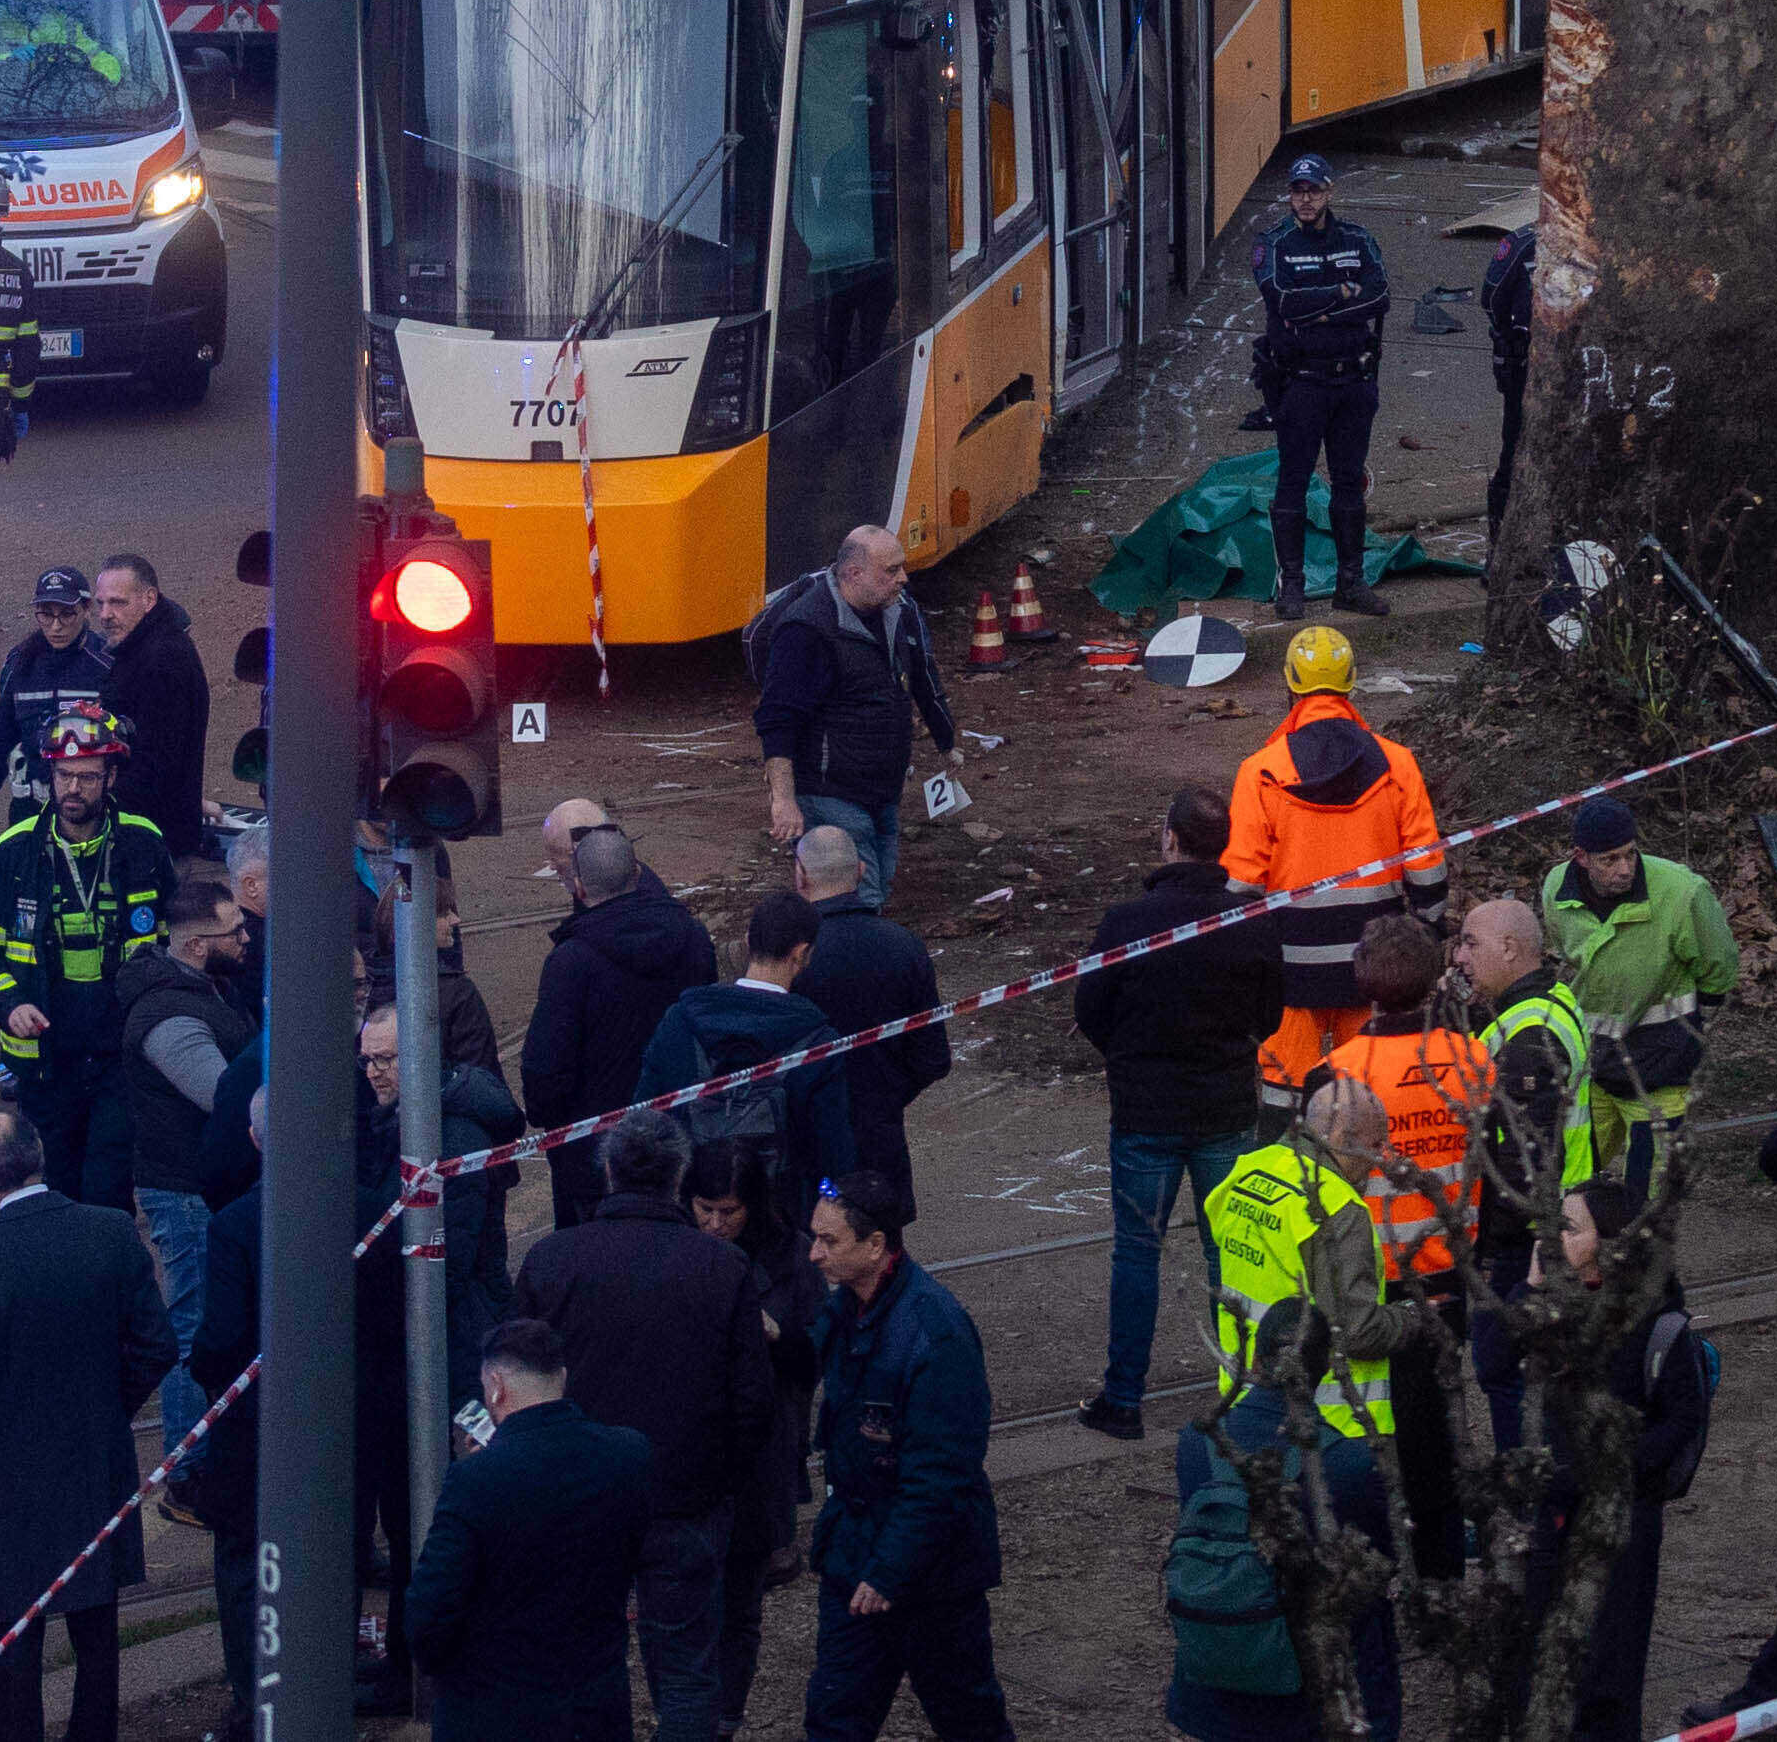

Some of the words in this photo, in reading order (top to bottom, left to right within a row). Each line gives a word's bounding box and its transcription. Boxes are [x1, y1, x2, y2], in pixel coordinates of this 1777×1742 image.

[22, 246, 65, 282] FIAT
[644, 362, 669, 372] ATM
[517, 708, 541, 735] A
[931, 779, 948, 808] 2
